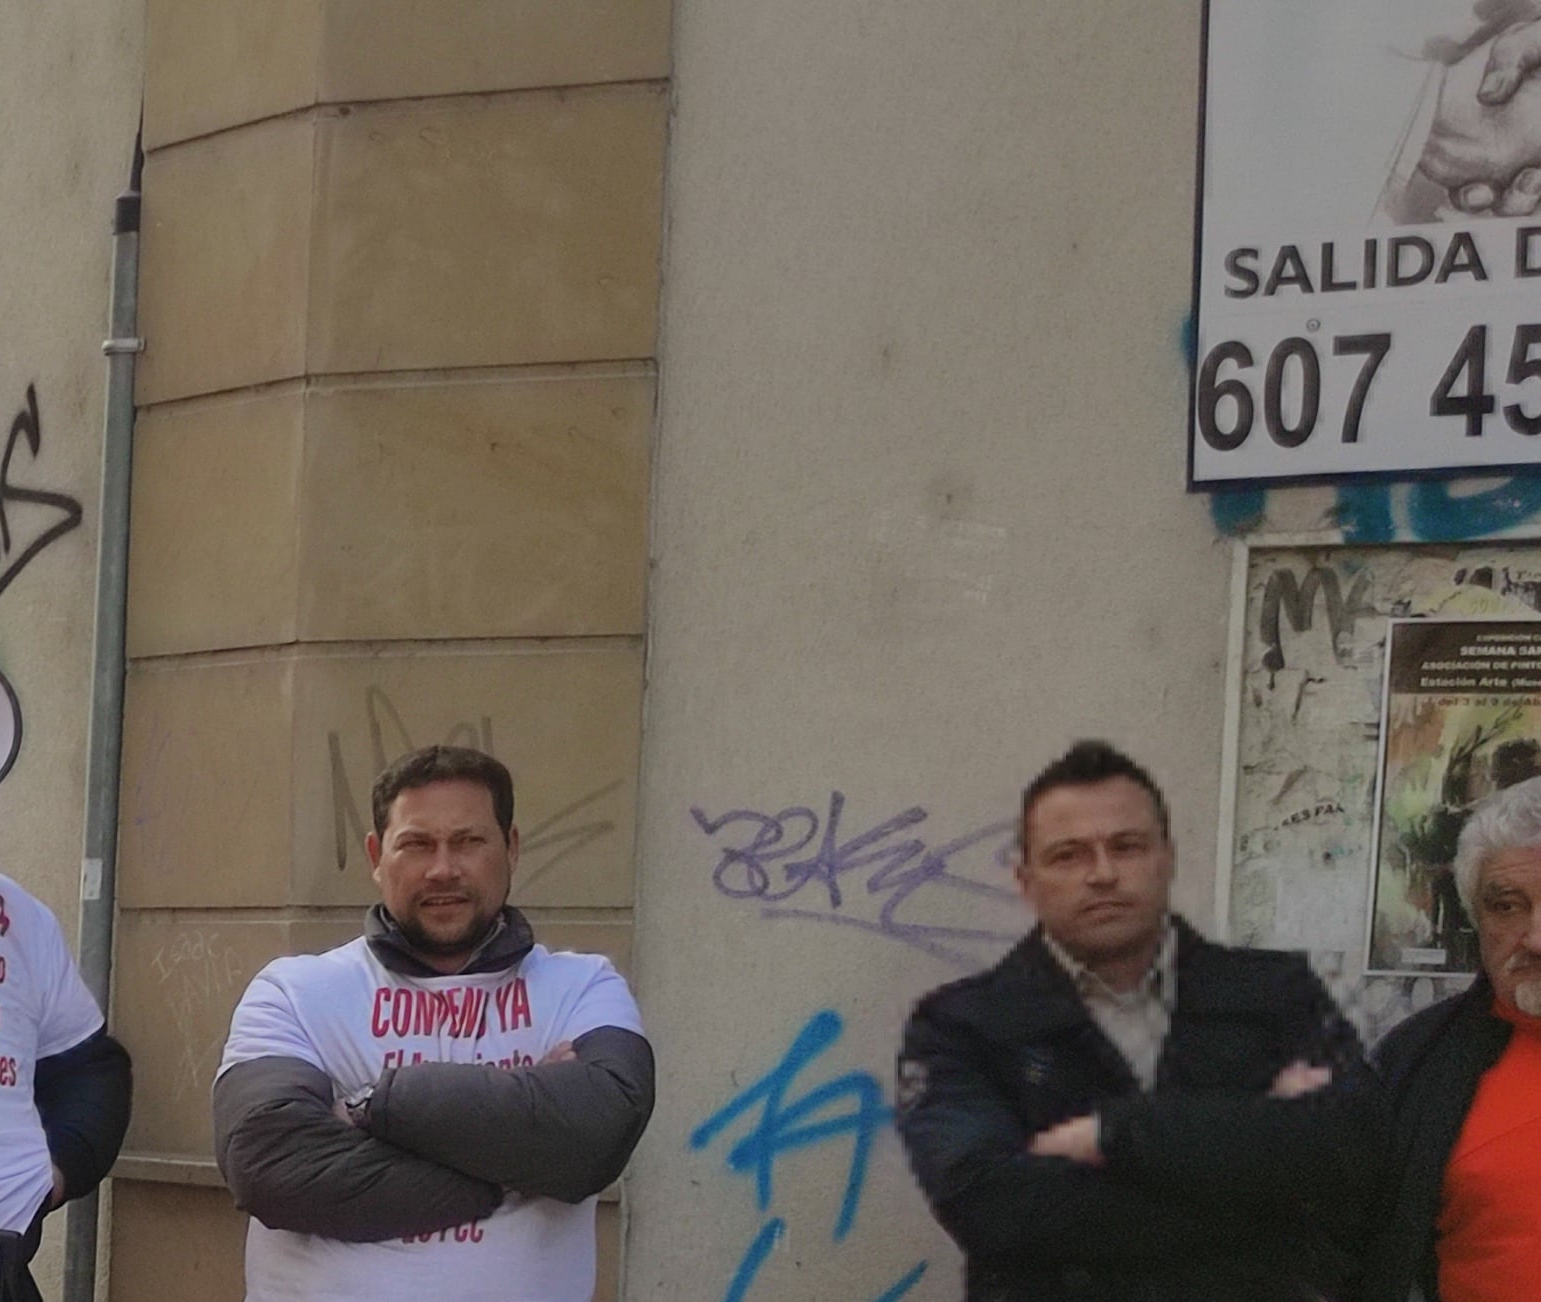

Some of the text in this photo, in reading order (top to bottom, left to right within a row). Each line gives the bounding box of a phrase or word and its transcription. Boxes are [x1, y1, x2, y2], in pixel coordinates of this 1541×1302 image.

[1223, 231, 1488, 299] SALIDA
[1197, 332, 1392, 453] 607
[1459, 645, 1517, 656] SEMANA
[496, 977, 532, 1033] YA
